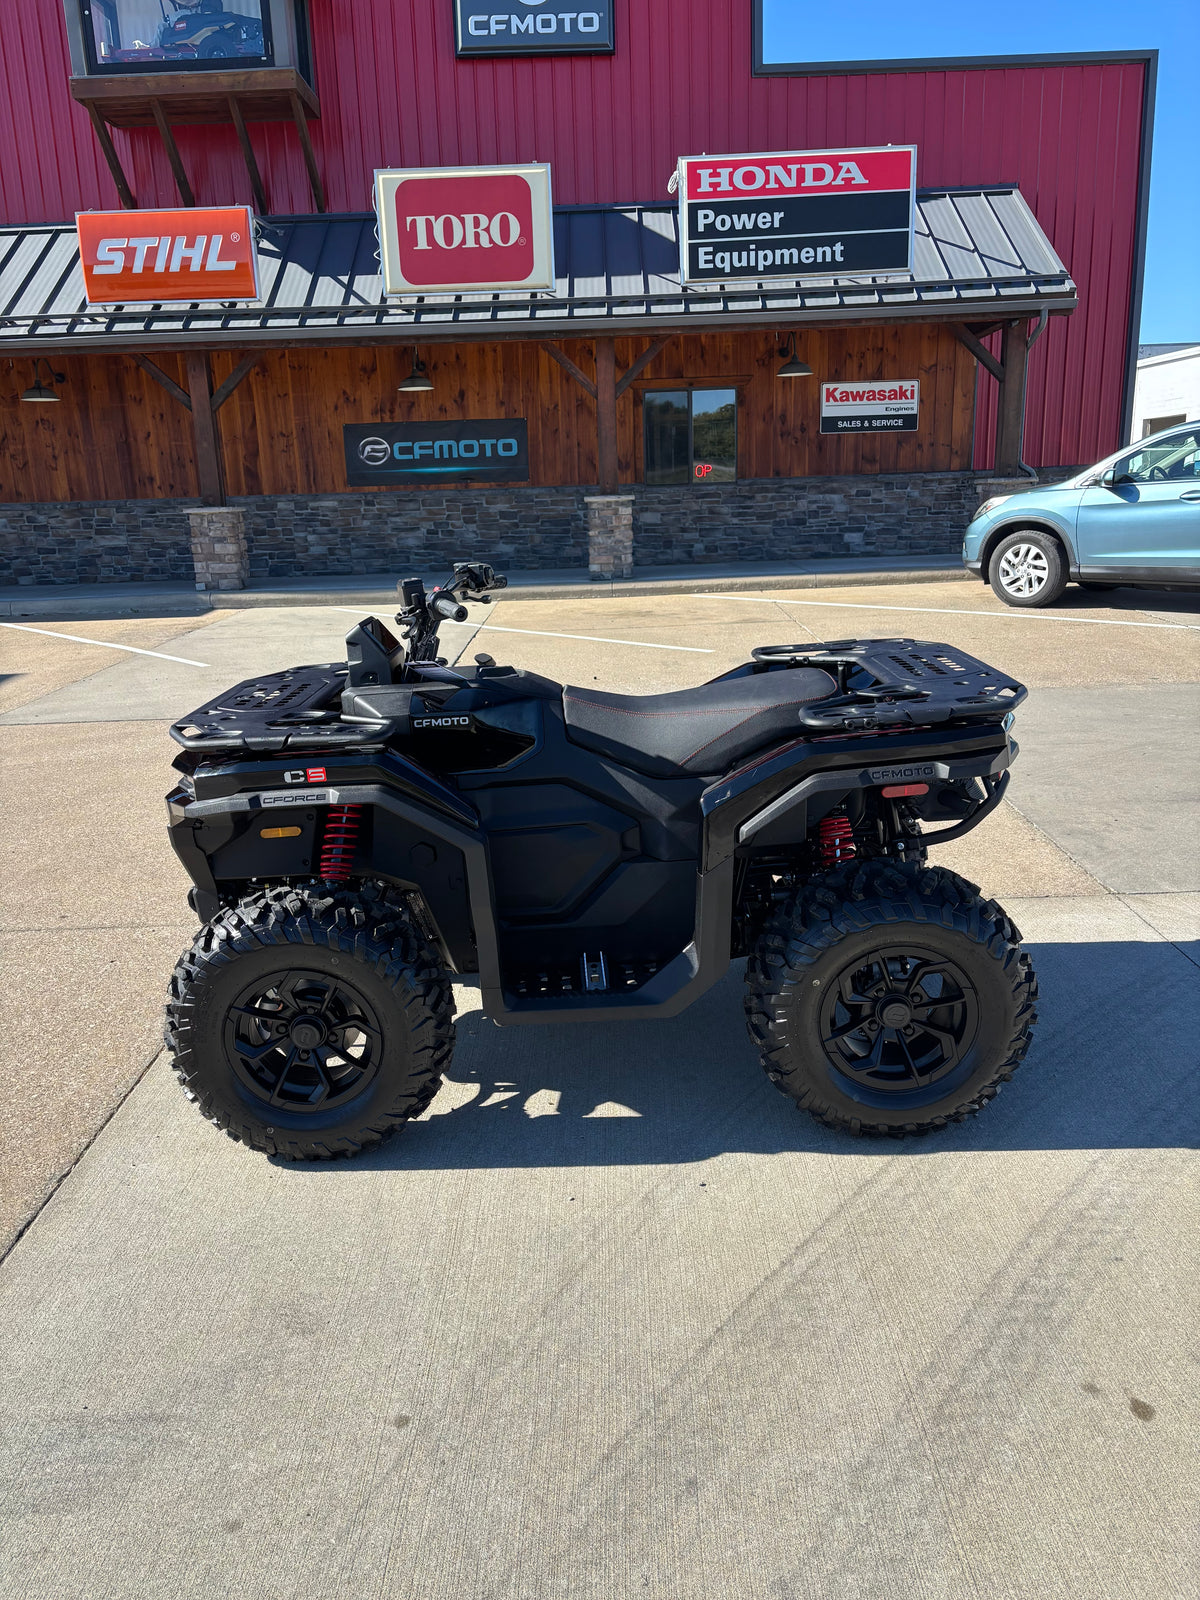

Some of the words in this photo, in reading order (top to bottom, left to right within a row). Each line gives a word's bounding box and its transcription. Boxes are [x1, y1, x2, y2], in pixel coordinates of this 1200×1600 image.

[468, 12, 600, 36] CFMOTO
[697, 161, 869, 193] HONDA
[406, 212, 521, 250] TORO
[697, 209, 785, 232] Power
[92, 234, 237, 275] STIHL
[698, 241, 845, 273] Equipment
[825, 385, 915, 403] Kawasaki
[837, 420, 861, 428] SALES
[871, 418, 904, 427] SERVICE
[392, 438, 518, 460] CFMOTO
[414, 716, 469, 728] CFMOTO
[871, 766, 934, 780] CFMOTO
[262, 793, 327, 804] CFORCE
